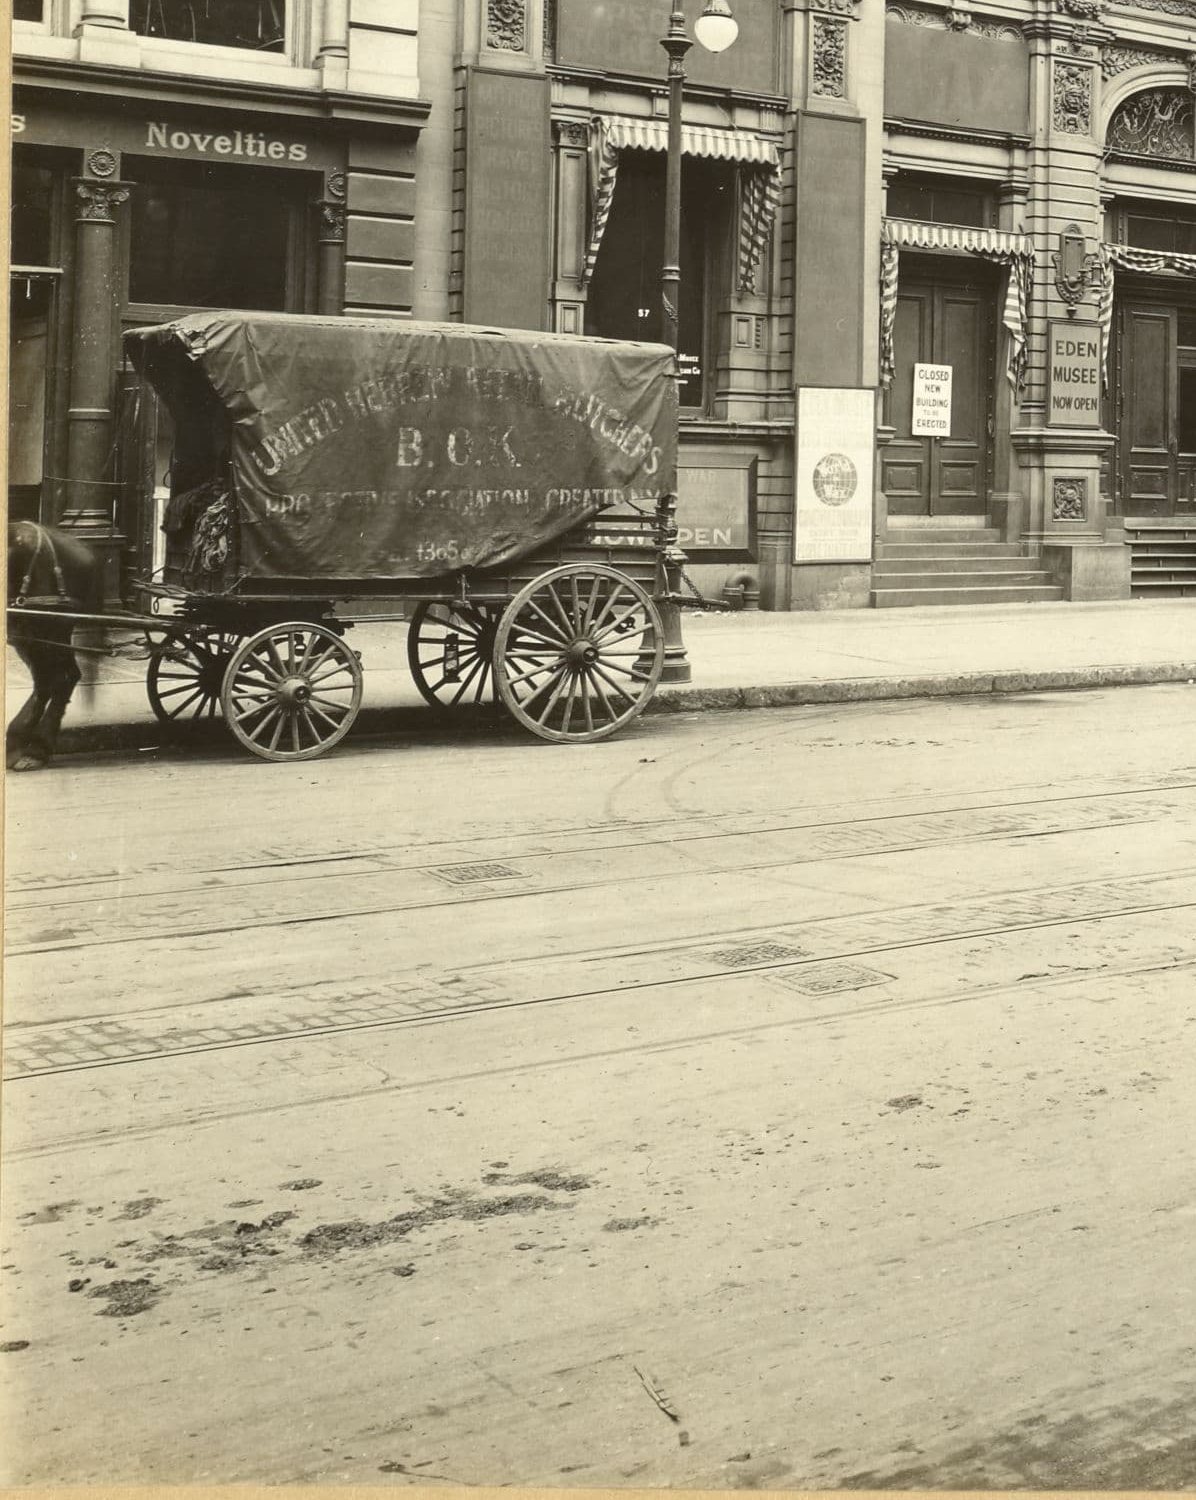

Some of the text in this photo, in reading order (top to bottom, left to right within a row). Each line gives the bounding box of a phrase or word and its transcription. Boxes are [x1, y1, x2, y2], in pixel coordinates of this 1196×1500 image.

[145, 122, 309, 162] Novelties
[1055, 339, 1098, 358] EDEN
[918, 368, 950, 382] CLOSED
[1052, 366, 1098, 385] MUSEE
[1052, 395, 1098, 411] NOW OPEN
